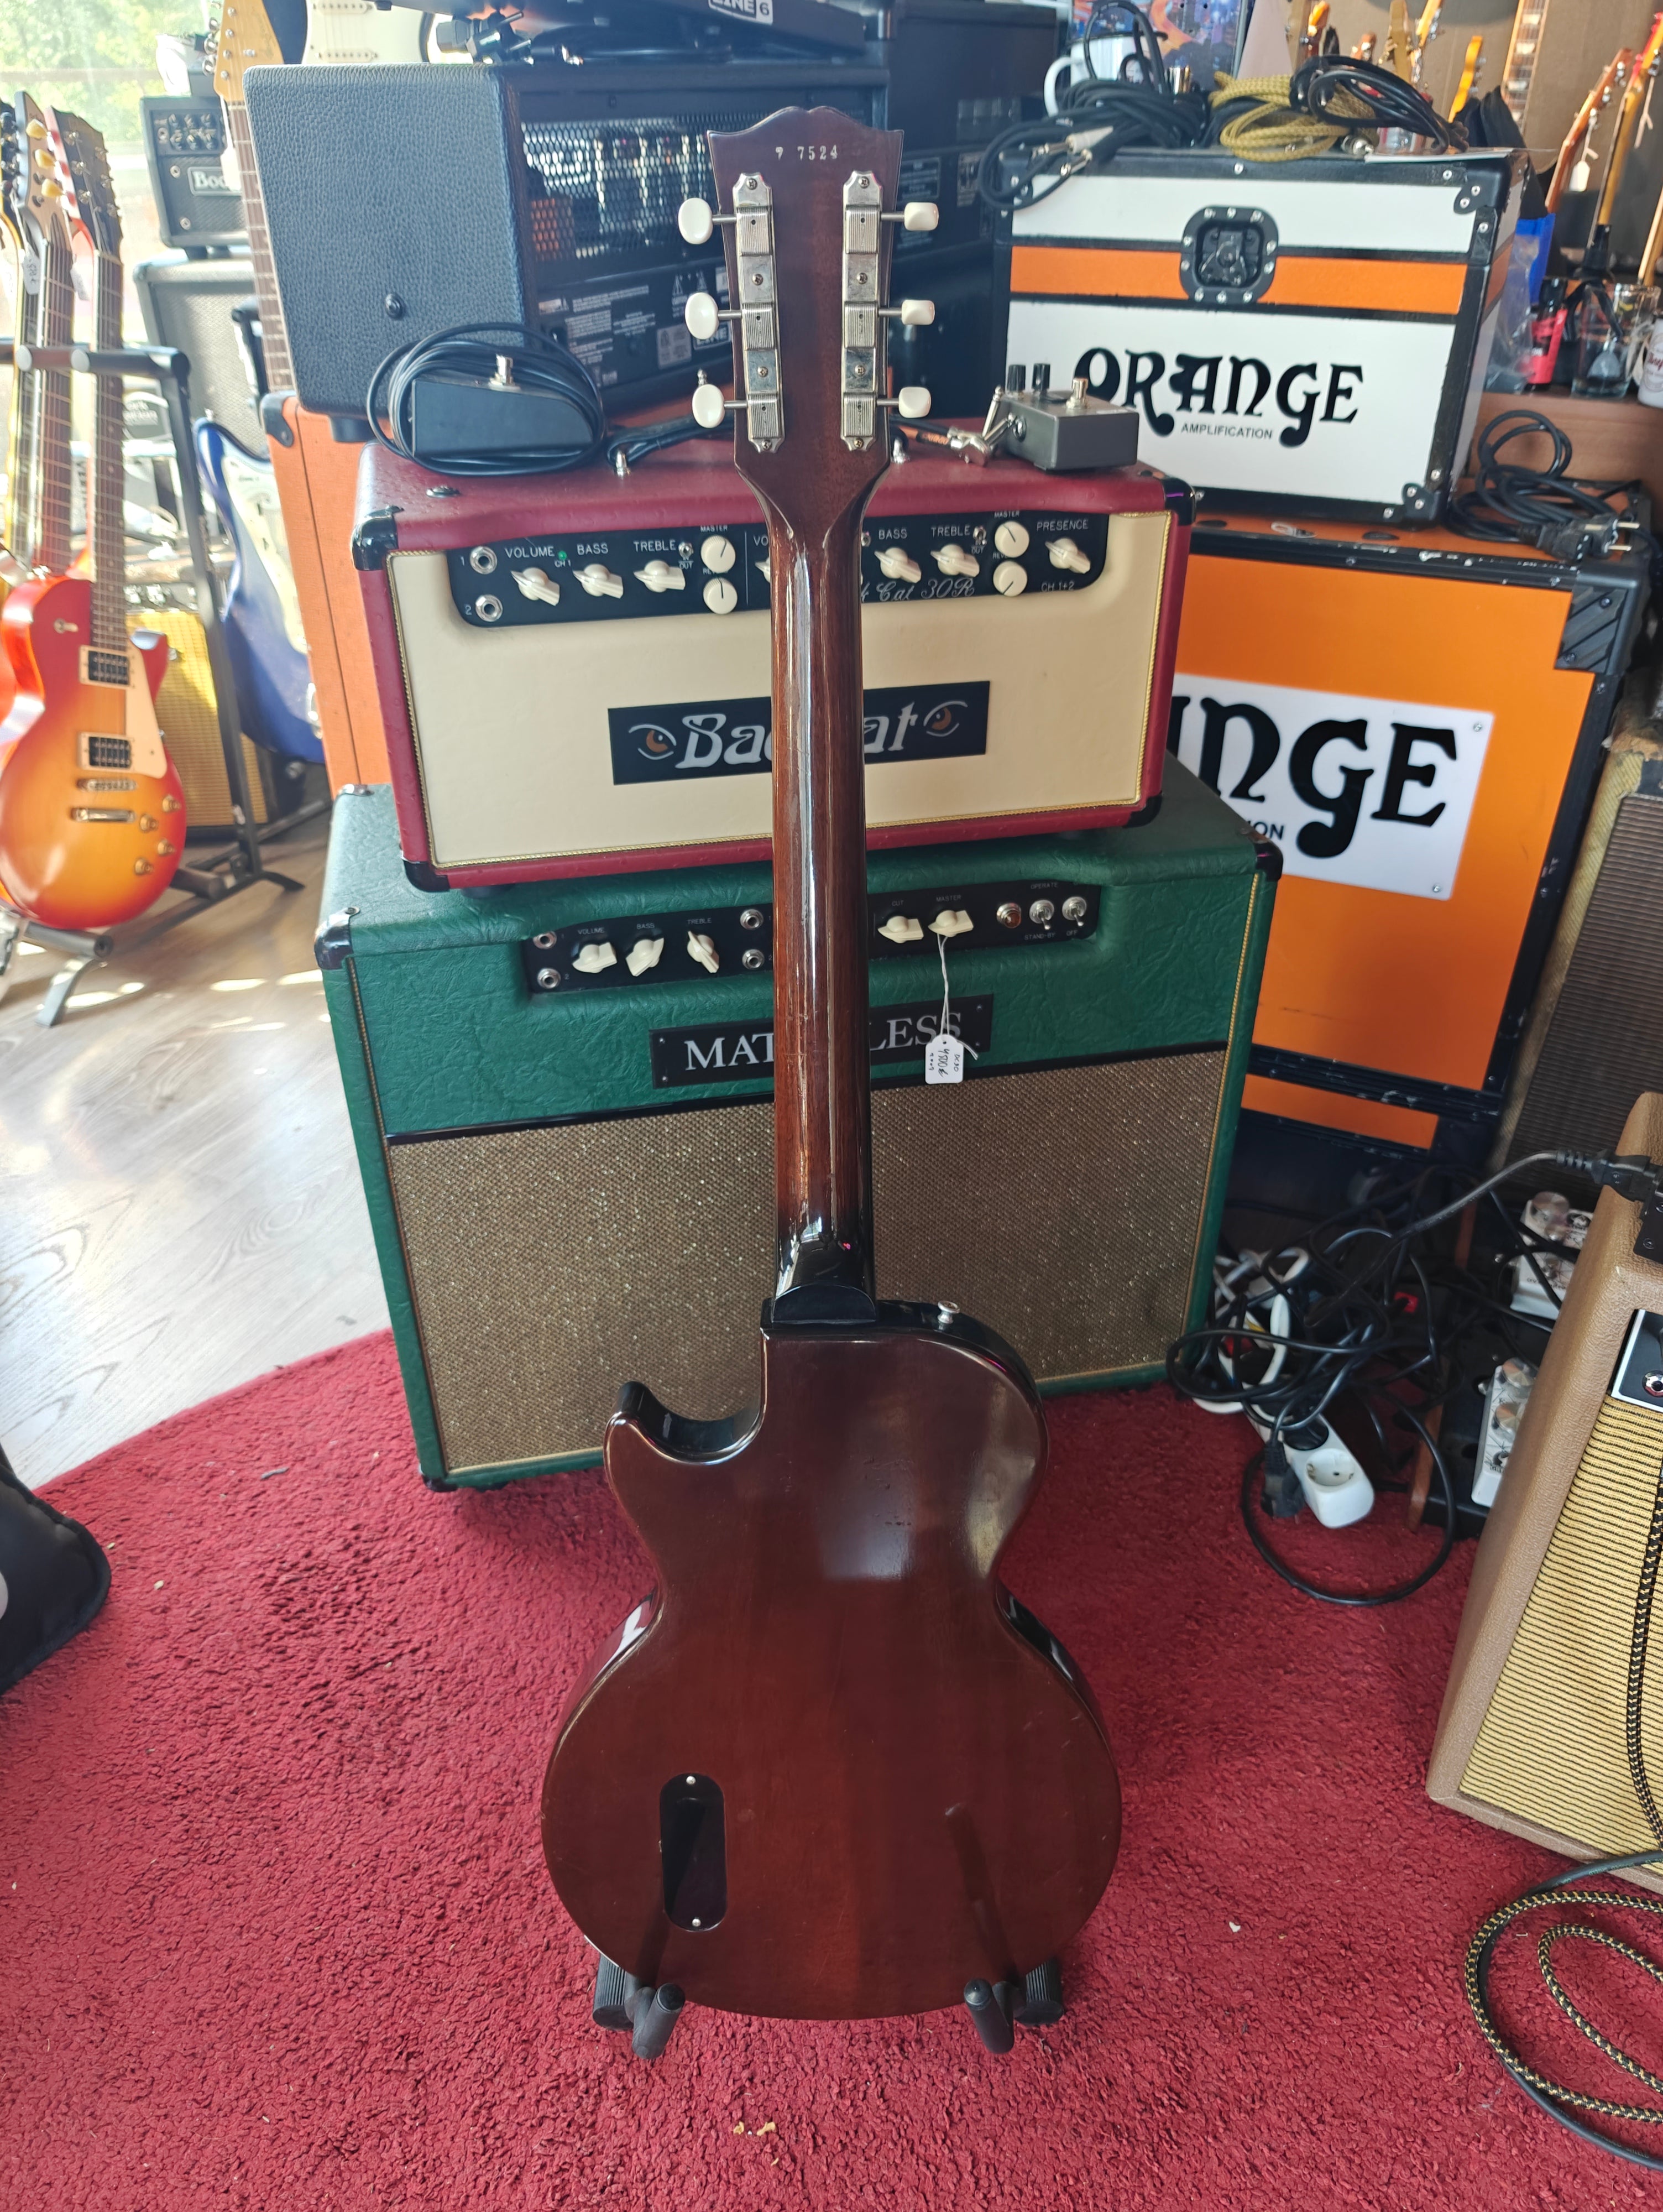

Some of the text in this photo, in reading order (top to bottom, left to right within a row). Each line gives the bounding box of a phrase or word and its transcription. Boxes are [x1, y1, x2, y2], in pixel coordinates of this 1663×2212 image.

[760, 2, 770, 15] 6
[797, 144, 838, 160] 7524
[1074, 347, 1363, 447] ORANGE
[1181, 422, 1273, 439] AMPLIFICATION
[931, 525, 970, 537] TREBLE
[1037, 520, 1089, 531] PRESENCE
[878, 529, 907, 540] BASS
[577, 543, 609, 555] BASS
[634, 539, 676, 552] TREBLE
[505, 546, 555, 559] VOLUME
[461, 556, 465, 566] 1
[876, 581, 914, 602] Cat
[921, 577, 975, 599] 30R
[1042, 582, 1054, 592] CH
[465, 605, 472, 615] 2
[674, 701, 918, 769] Ba at
